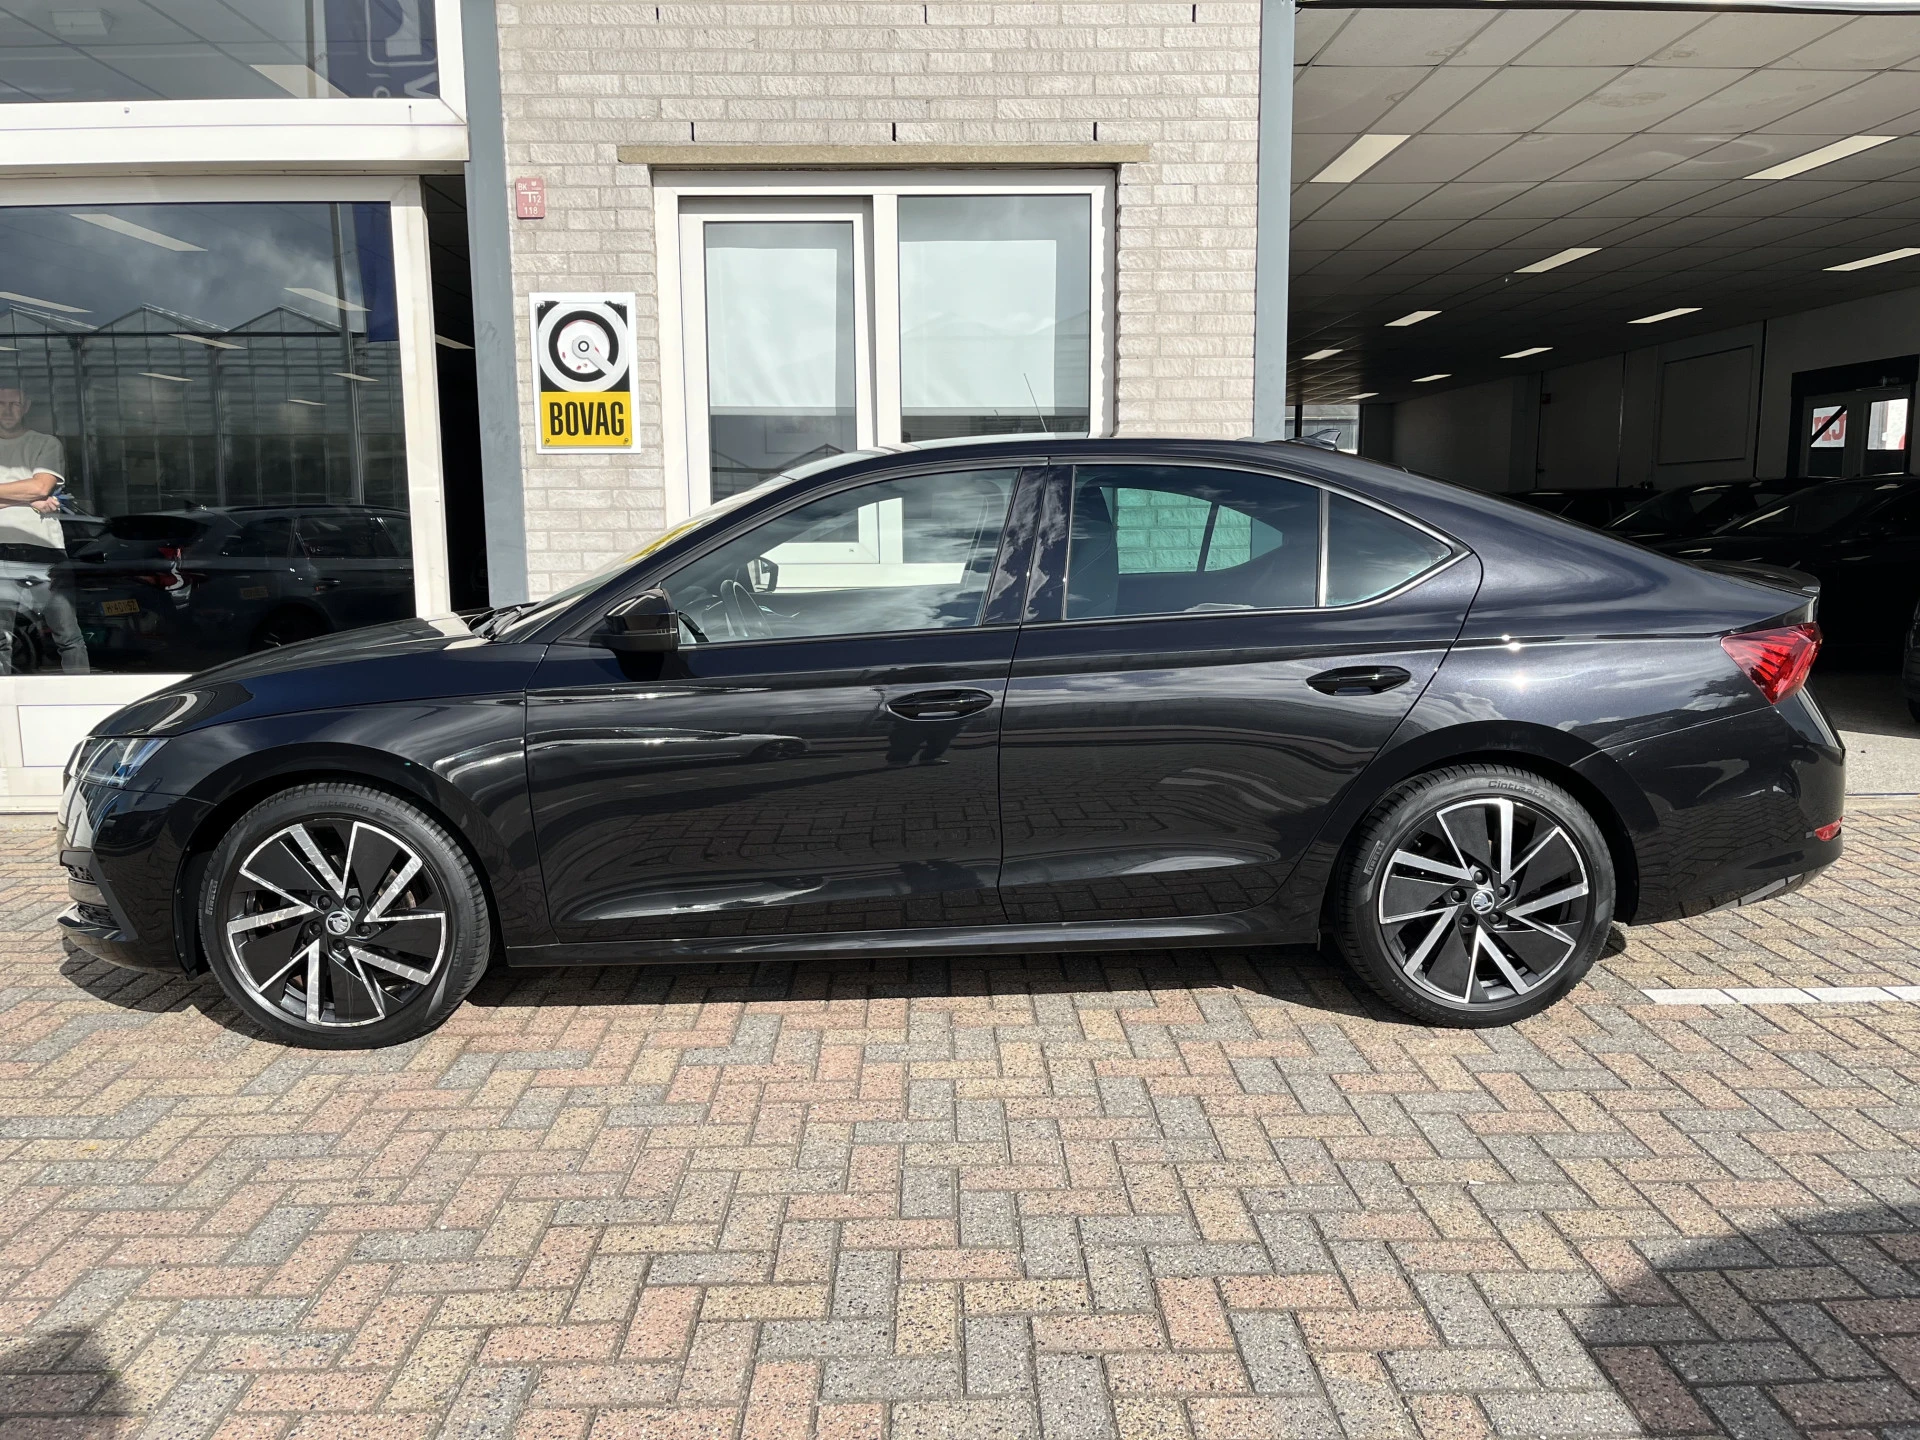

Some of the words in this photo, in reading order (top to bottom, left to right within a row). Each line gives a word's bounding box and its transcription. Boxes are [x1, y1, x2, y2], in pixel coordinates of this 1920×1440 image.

[518, 183, 527, 191] BK
[524, 206, 538, 214] 118
[549, 401, 625, 437] BOVAG
[1488, 780, 1546, 798] Cinturato
[1363, 839, 1386, 877] PIRELLI
[204, 878, 219, 917] PIRELLI
